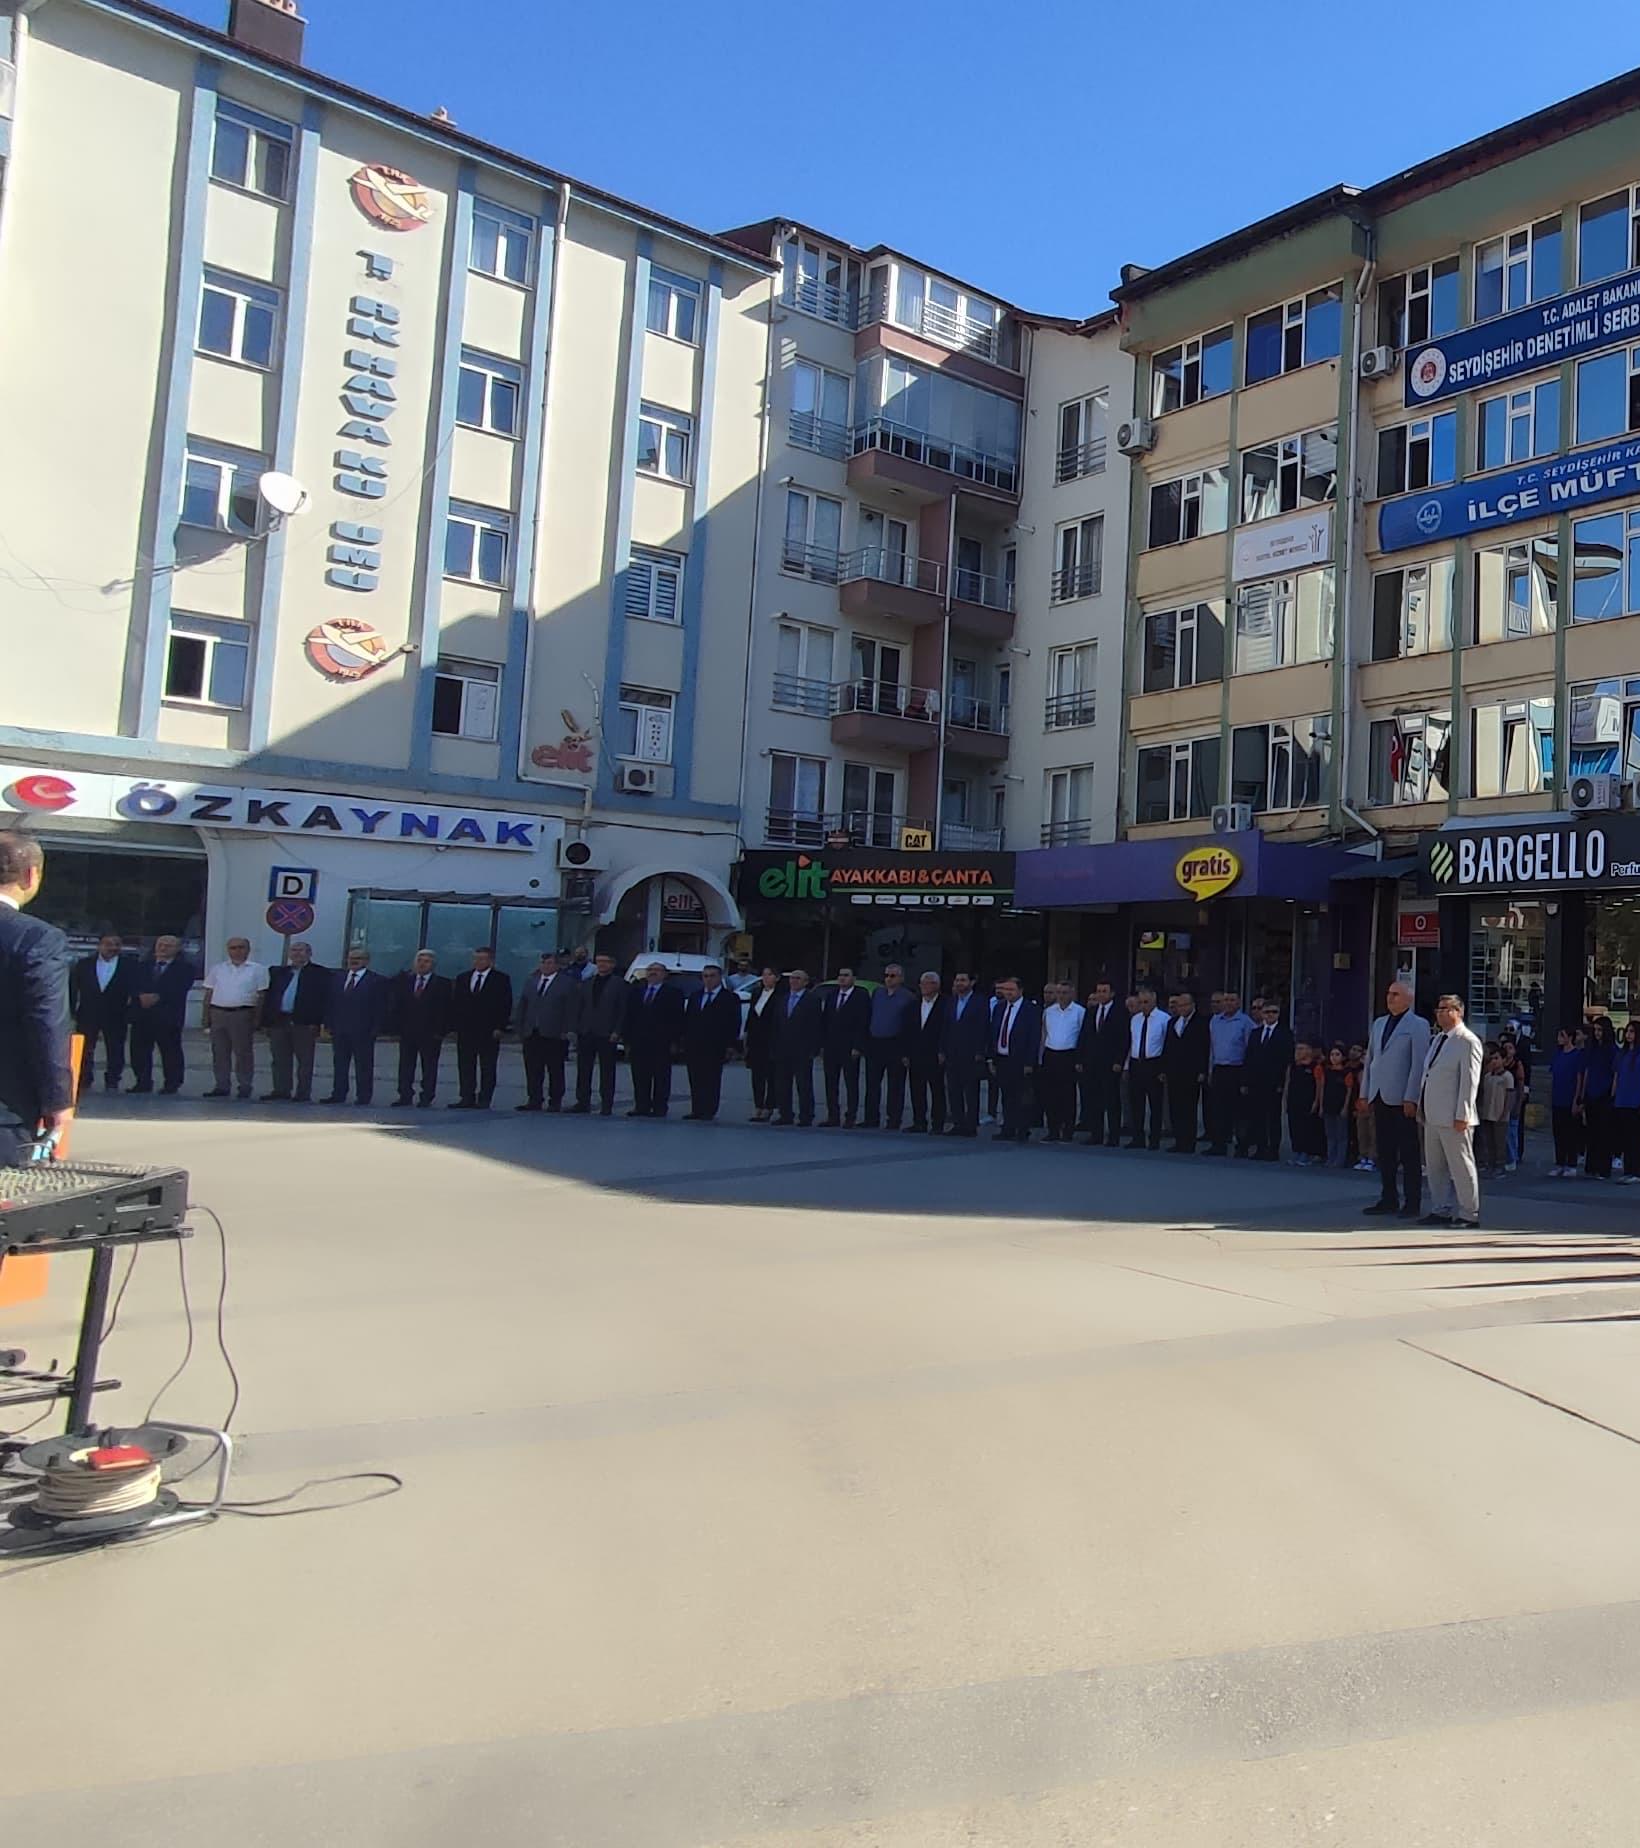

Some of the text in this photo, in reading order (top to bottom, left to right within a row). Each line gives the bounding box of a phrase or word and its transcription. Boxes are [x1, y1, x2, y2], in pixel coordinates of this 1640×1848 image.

[1542, 308, 1560, 326] T.C.
[1562, 293, 1600, 320] ADALET
[1449, 339, 1524, 384] SEYDİŞEHİR
[1527, 312, 1598, 358] DENETİMLİ
[1517, 474, 1540, 486] T.C.
[1543, 450, 1622, 479] SEYDİŞEHİR
[1468, 487, 1540, 522] İLÇE
[116, 781, 535, 847] ÖZKAYNAK
[904, 834, 928, 849] CAT
[1458, 830, 1605, 885] BARGELLO
[283, 875, 304, 895] D
[759, 855, 830, 899] elit
[1182, 852, 1231, 884] gratis
